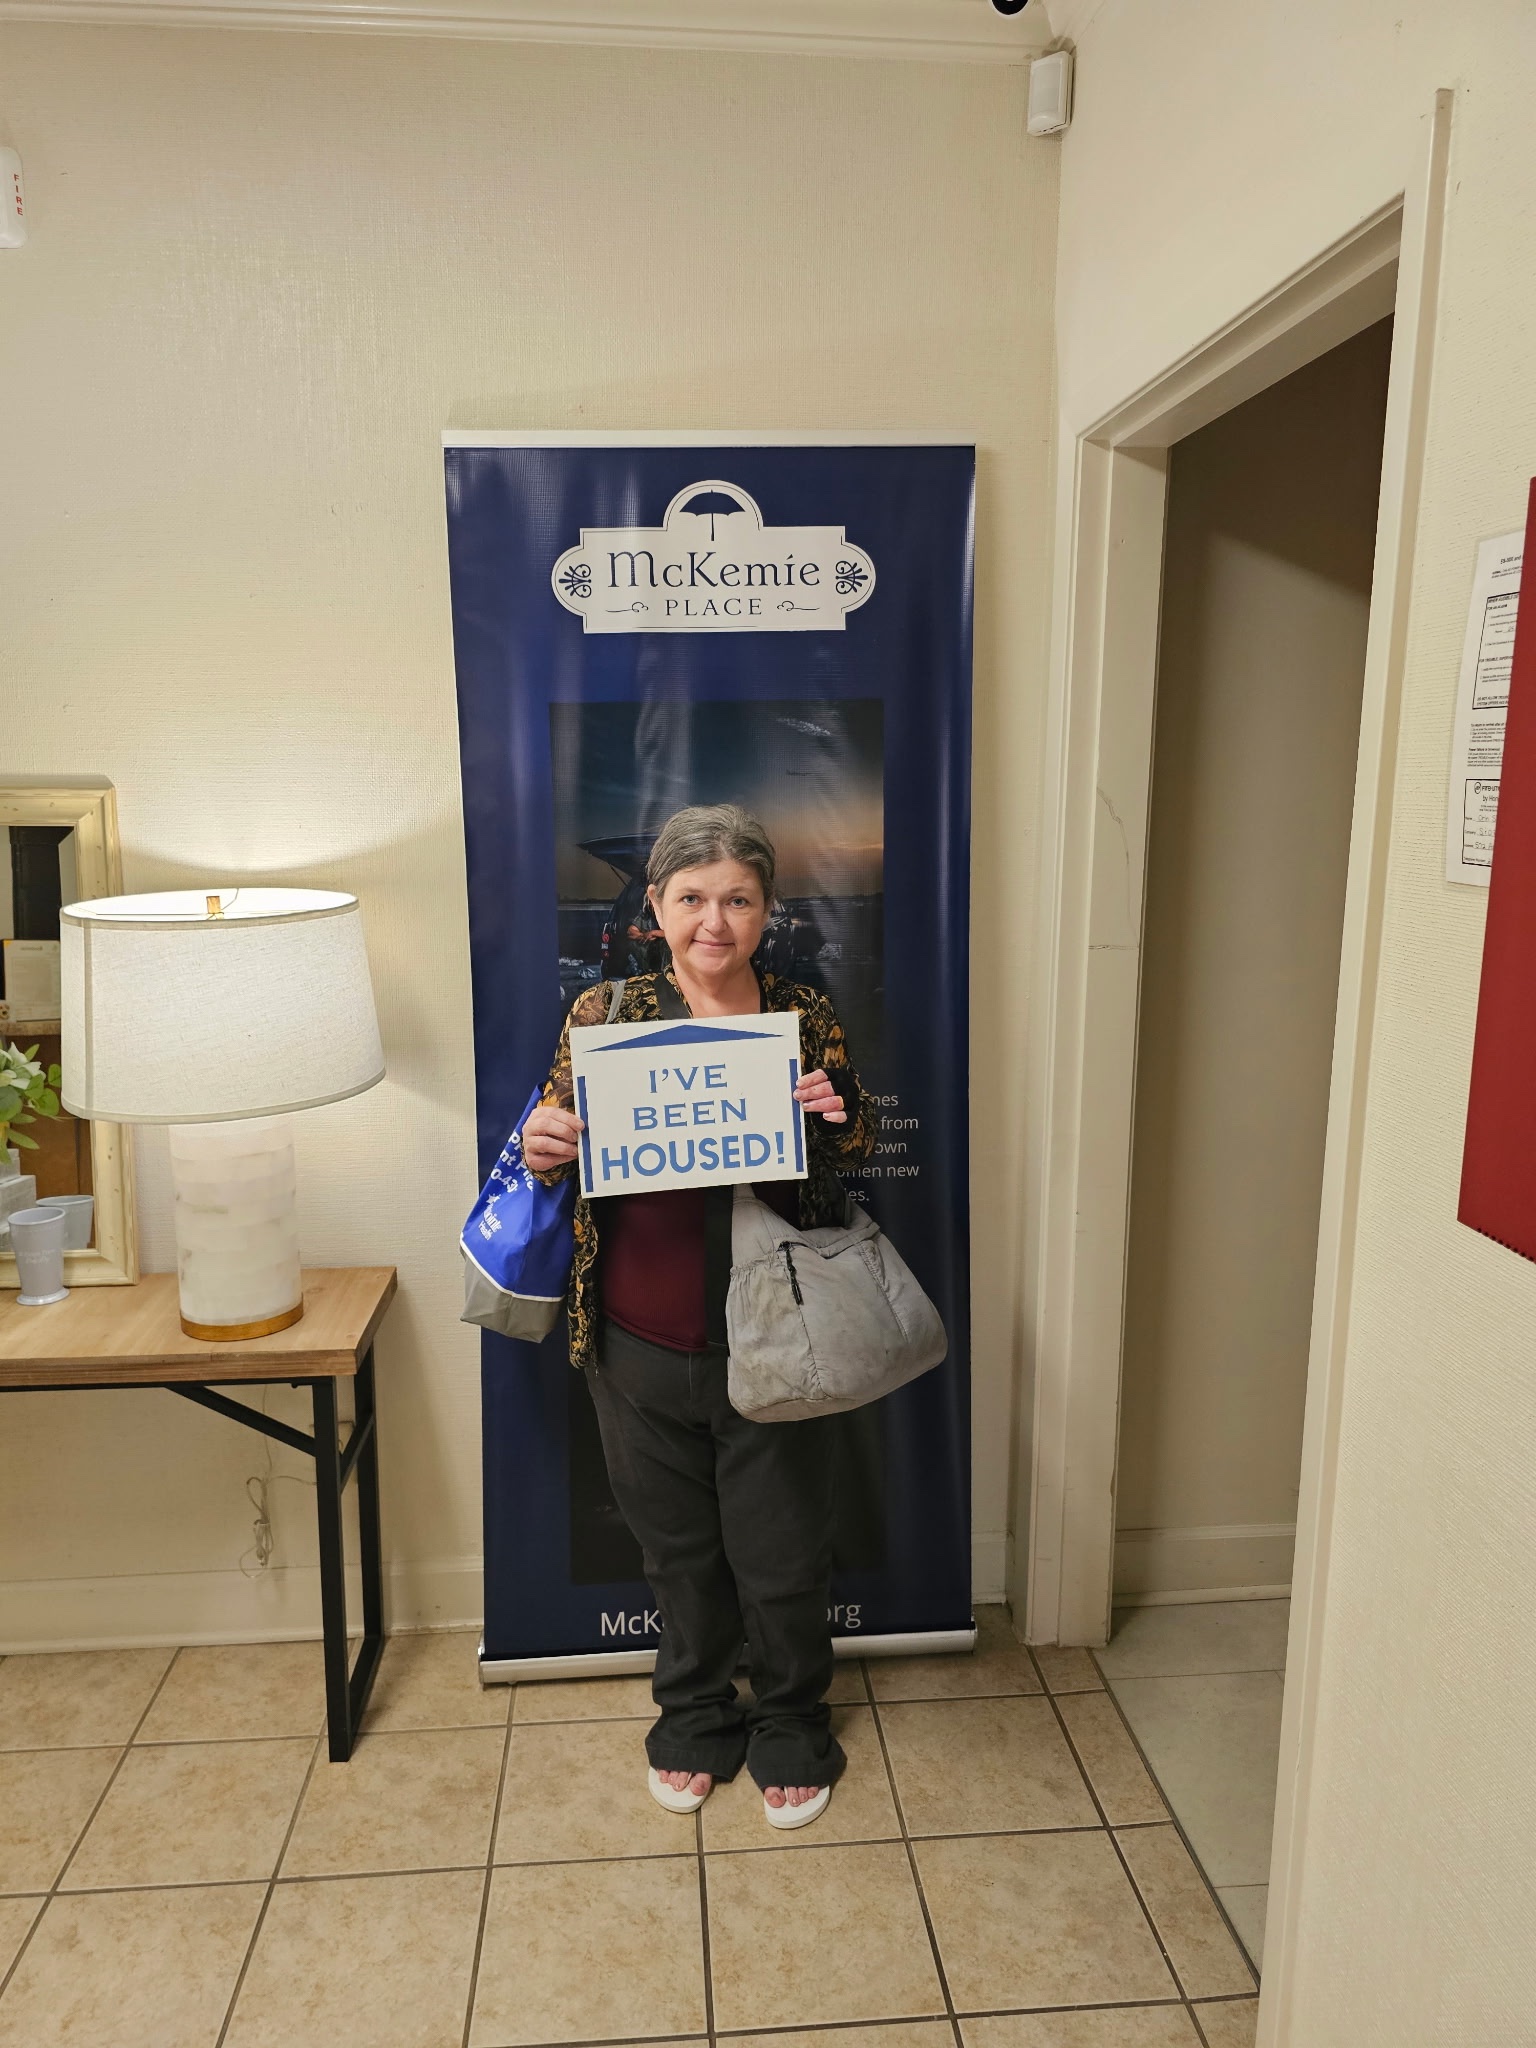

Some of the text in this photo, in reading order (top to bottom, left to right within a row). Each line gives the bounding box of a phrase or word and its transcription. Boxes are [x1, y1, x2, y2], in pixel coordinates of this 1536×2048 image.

[13, 173, 23, 216] FIRE
[607, 550, 821, 588] McKemie
[665, 598, 763, 616] PLACE
[649, 1063, 728, 1094] I'VE
[632, 1097, 748, 1131] BEEN
[880, 1115, 919, 1130] from
[601, 1131, 785, 1181] HOUSED!
[835, 1165, 920, 1178] omen new
[844, 1187, 870, 1202] es.
[601, 1609, 665, 1637] McK
